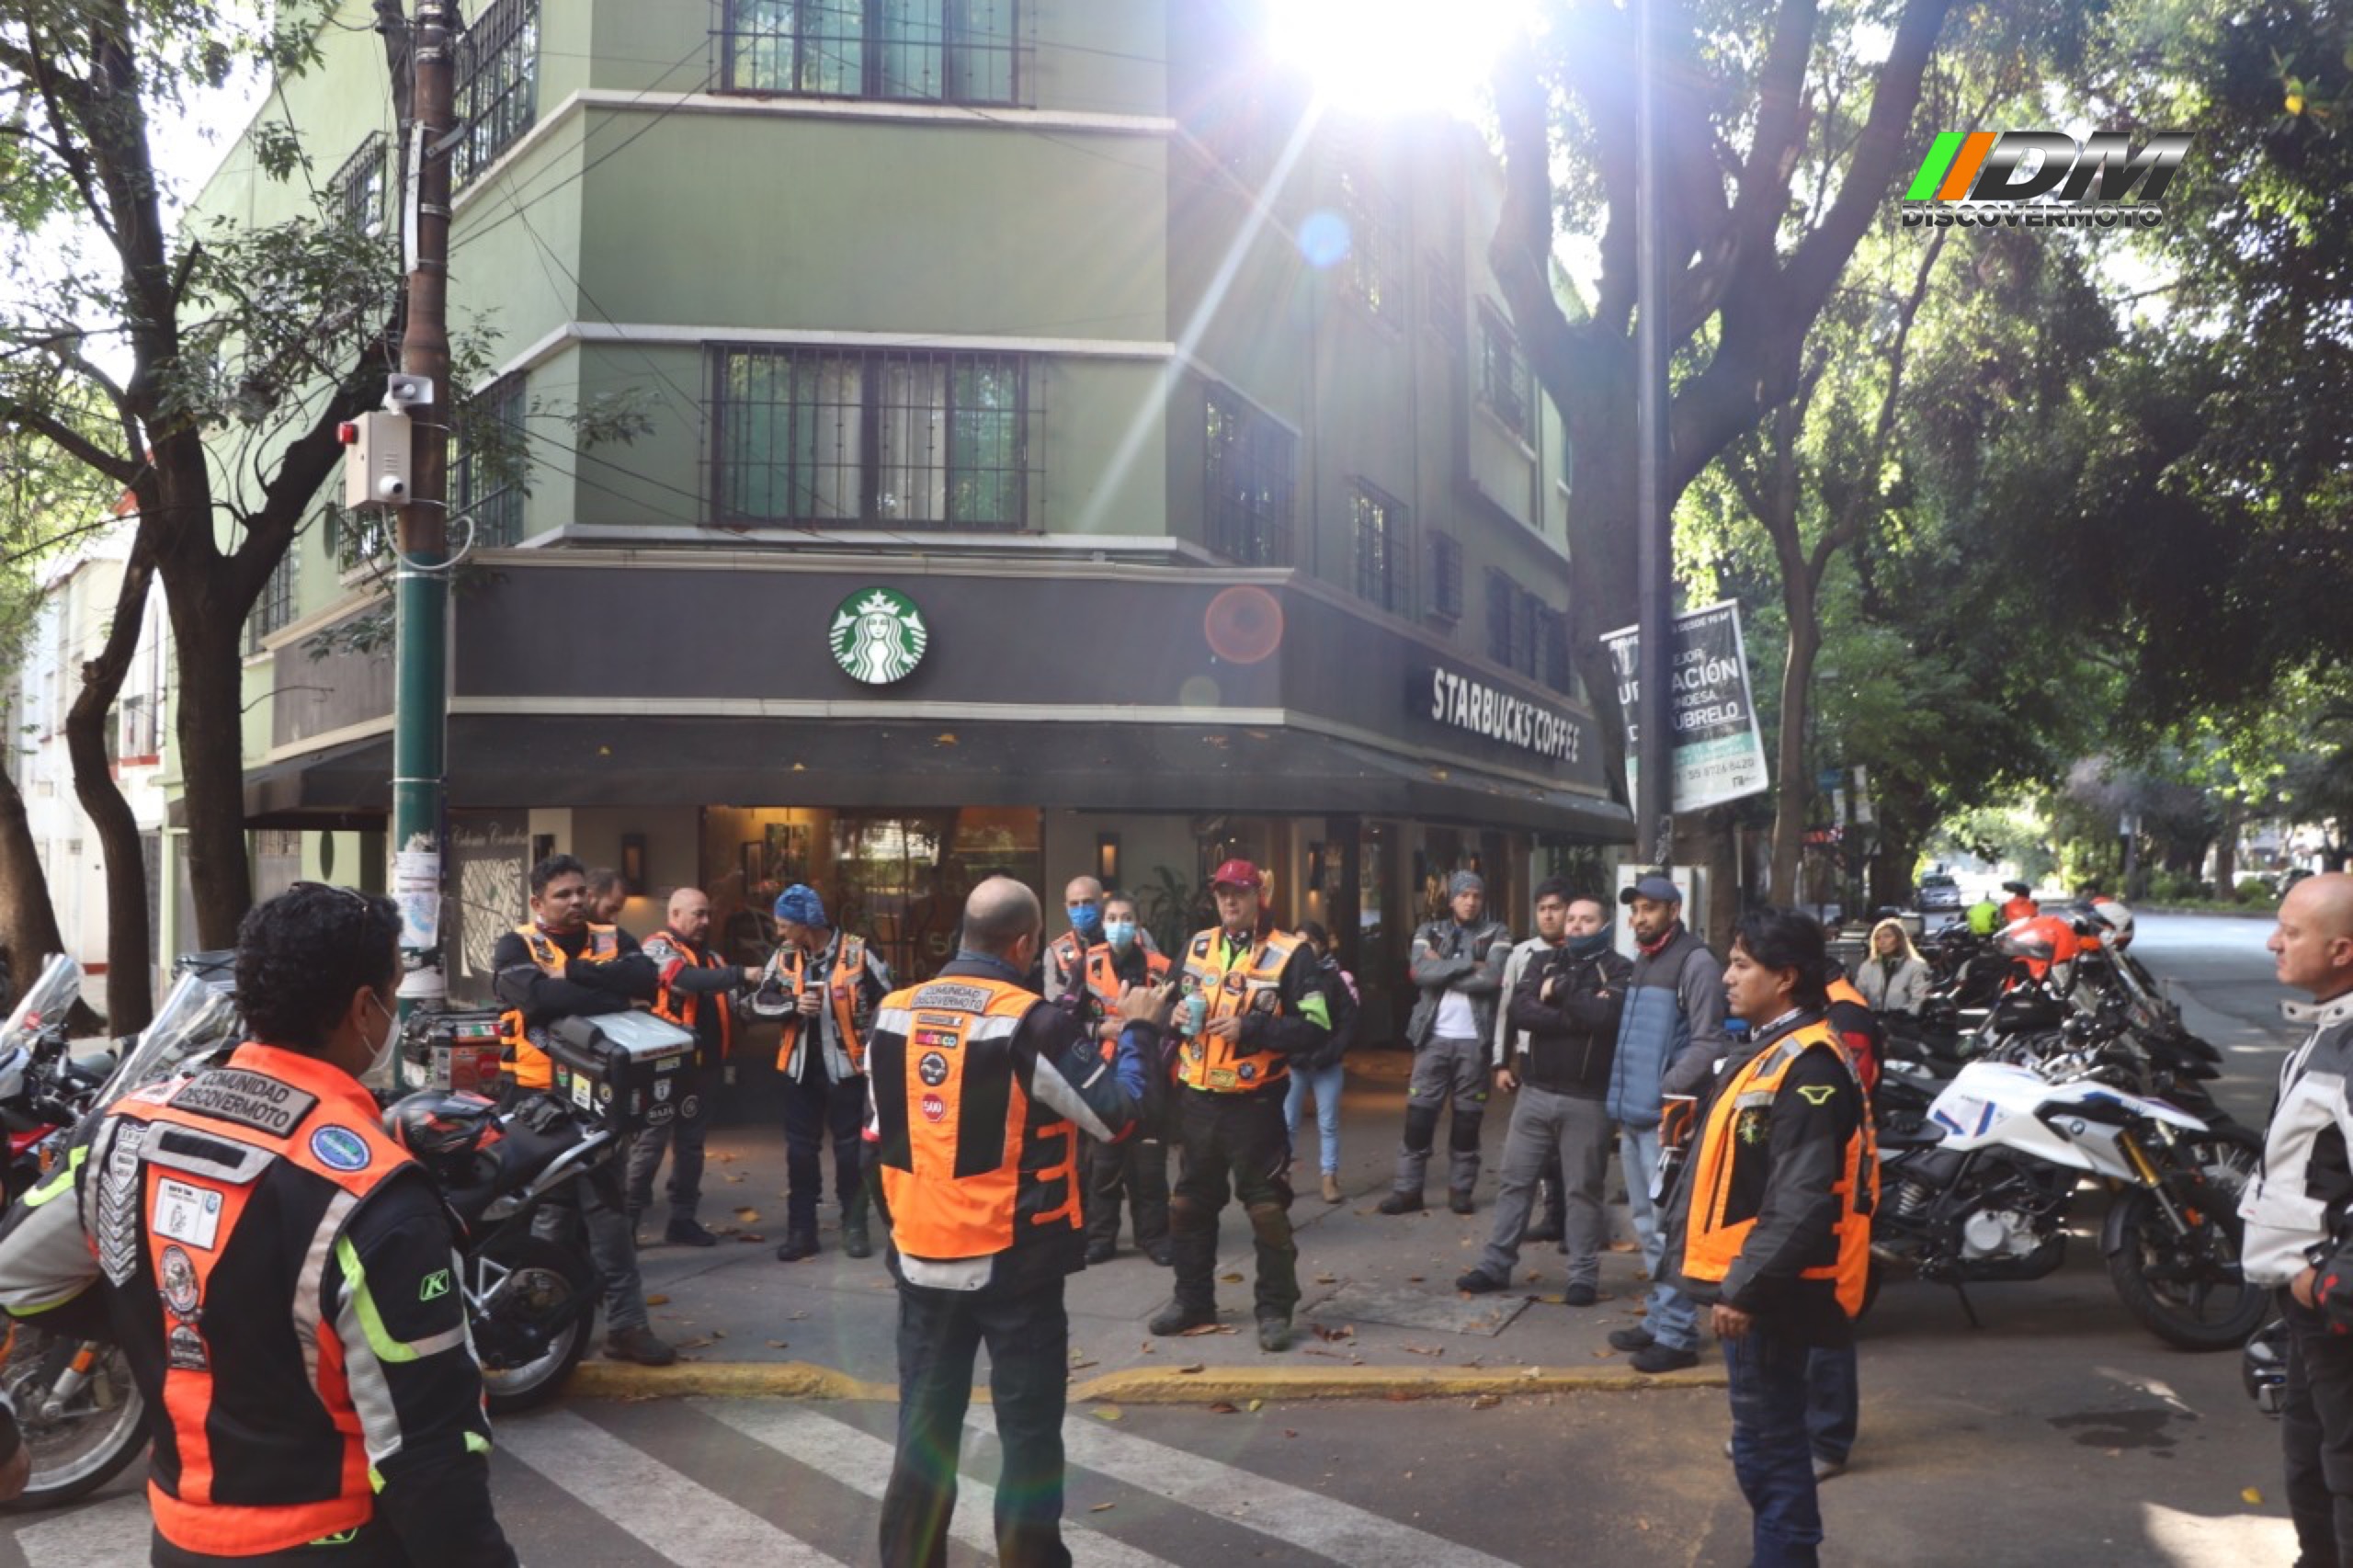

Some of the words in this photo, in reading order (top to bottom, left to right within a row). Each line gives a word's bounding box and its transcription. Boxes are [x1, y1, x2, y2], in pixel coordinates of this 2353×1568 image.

[1673, 648, 1706, 666] EJOR
[1431, 667, 1533, 749] STARBUCKS
[1534, 707, 1580, 764] COFFEE
[925, 985, 982, 1000] COMUNIDAD
[914, 995, 984, 1010] DISCOVERMOTO
[201, 1072, 290, 1104] COMUNIDAD
[177, 1087, 290, 1128] DISCOVERMOTO
[922, 1100, 942, 1113] 500
